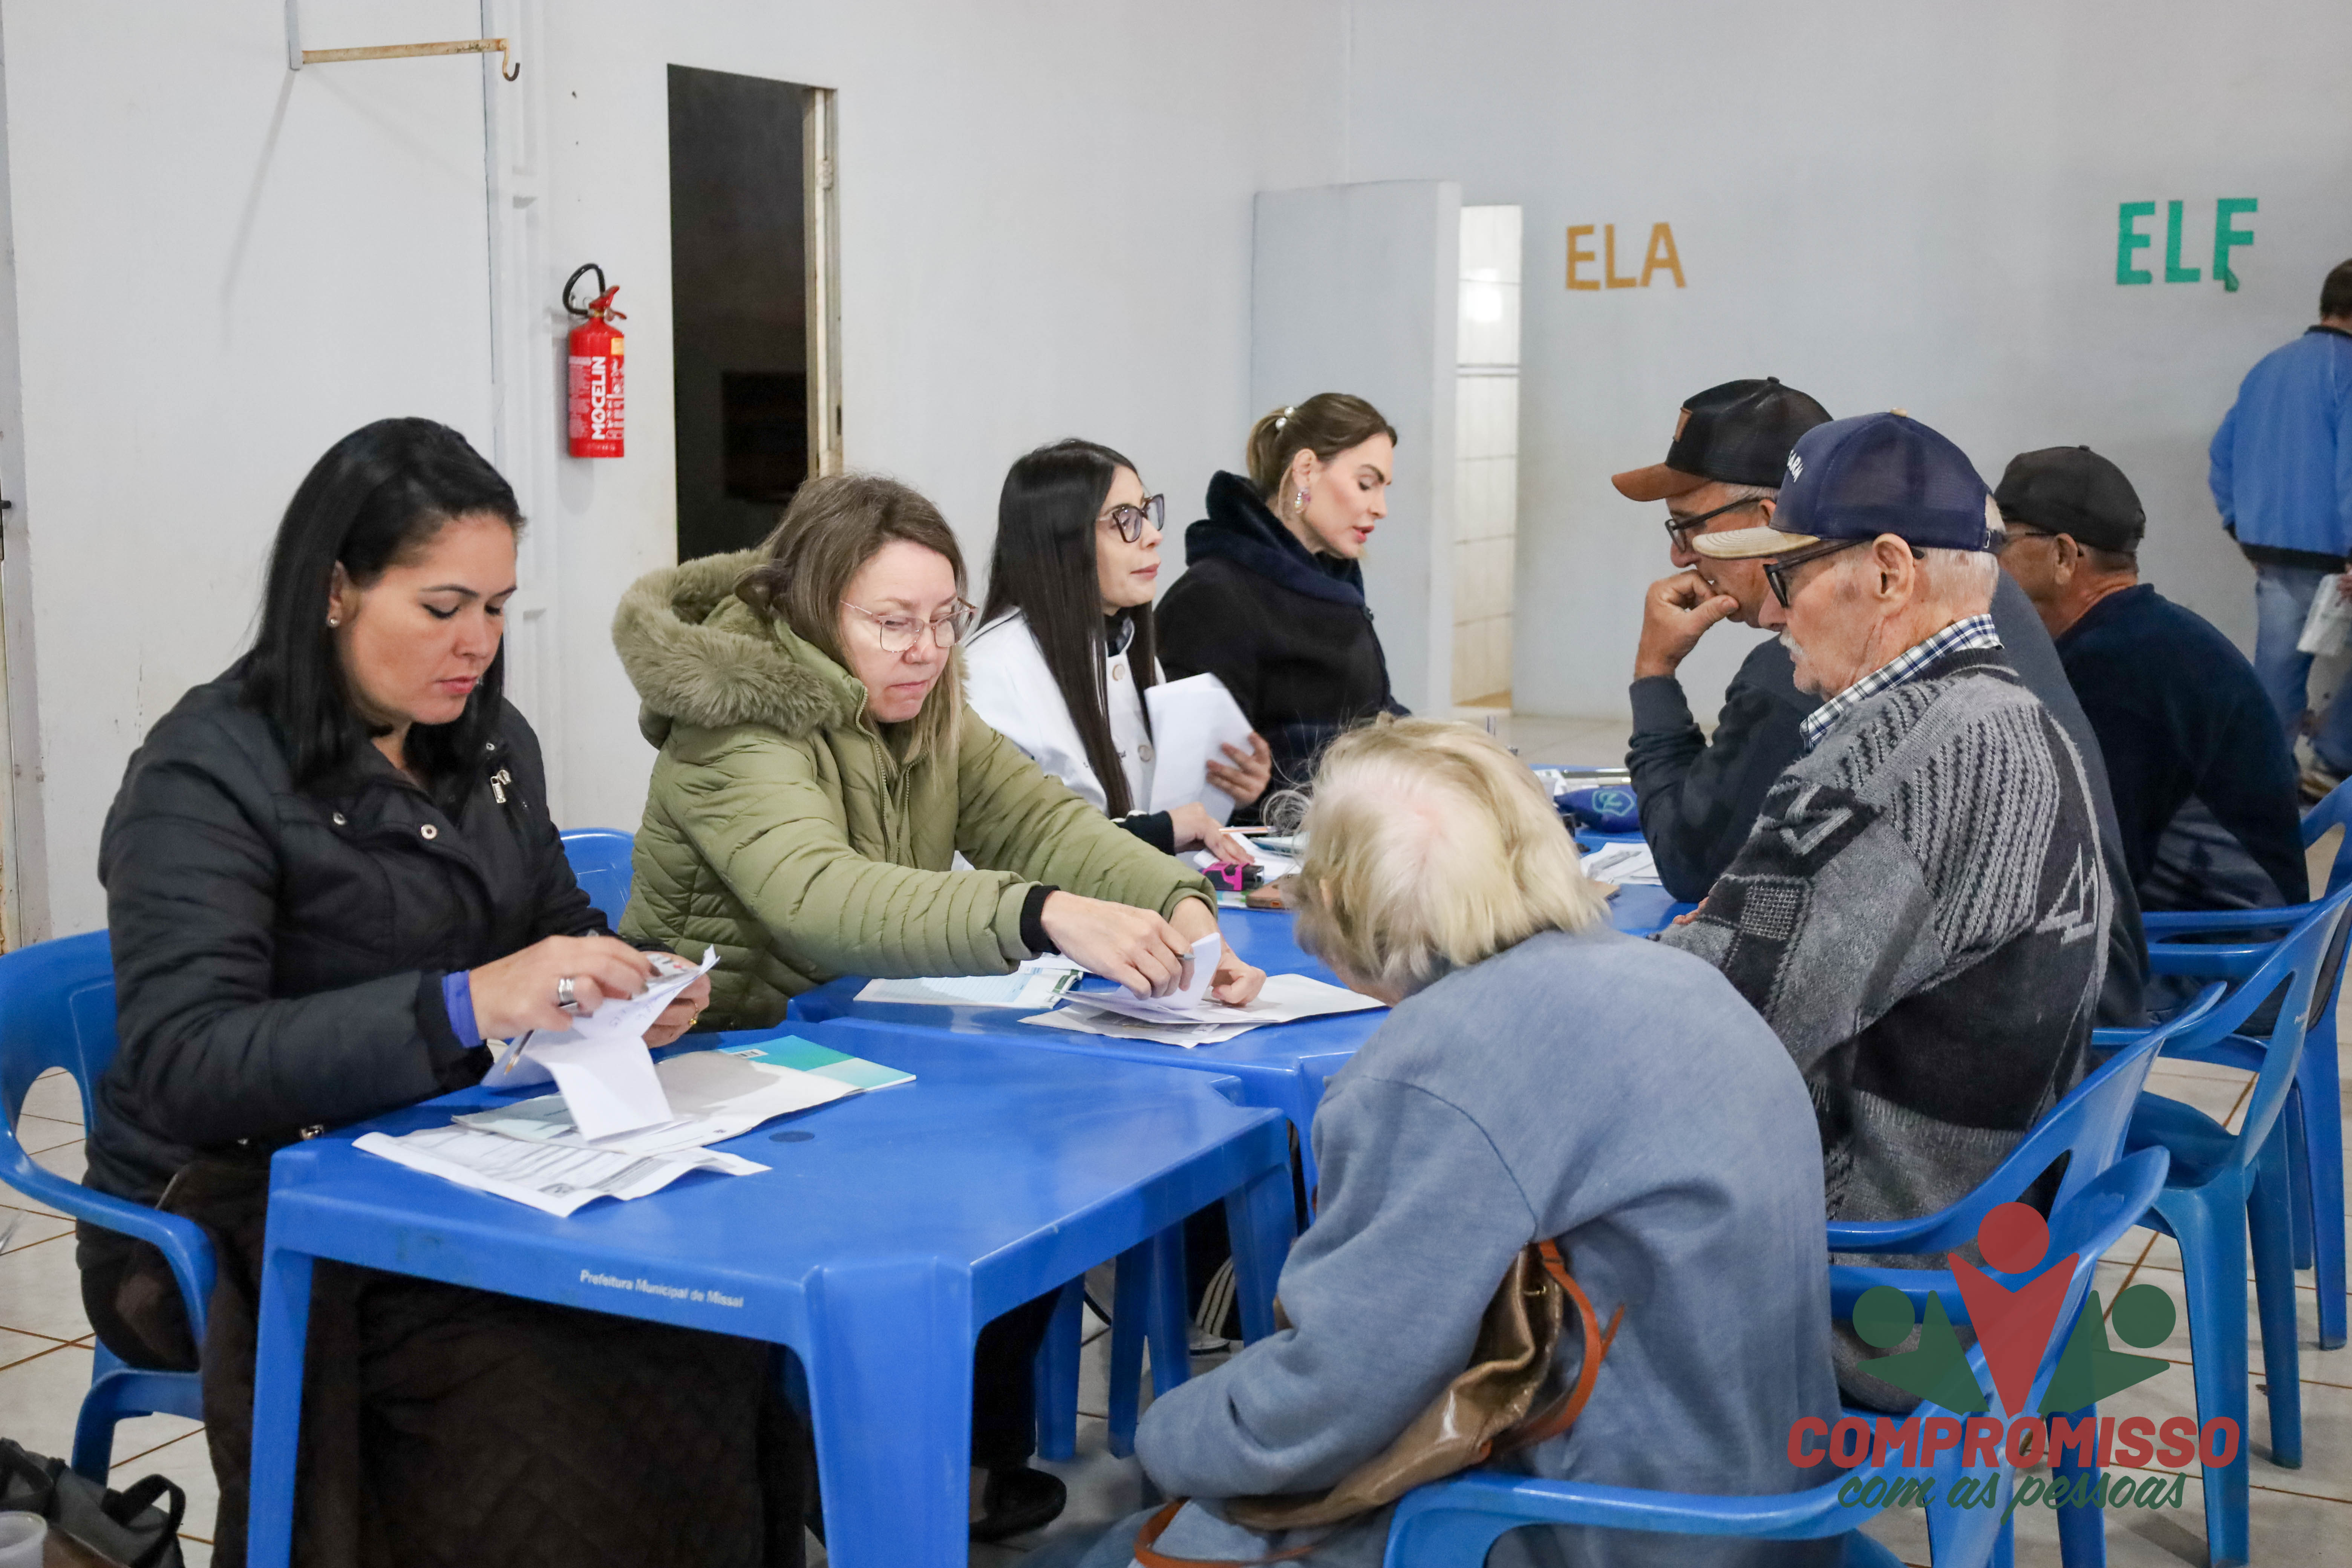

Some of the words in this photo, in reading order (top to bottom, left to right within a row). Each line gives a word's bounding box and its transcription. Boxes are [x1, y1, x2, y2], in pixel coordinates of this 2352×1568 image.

[1566, 222, 1686, 291] ELA
[591, 356, 606, 440] MOCELIN
[580, 1269, 634, 1290] Prefeitura
[635, 1278, 689, 1299] Municipal
[690, 1289, 704, 1302] de
